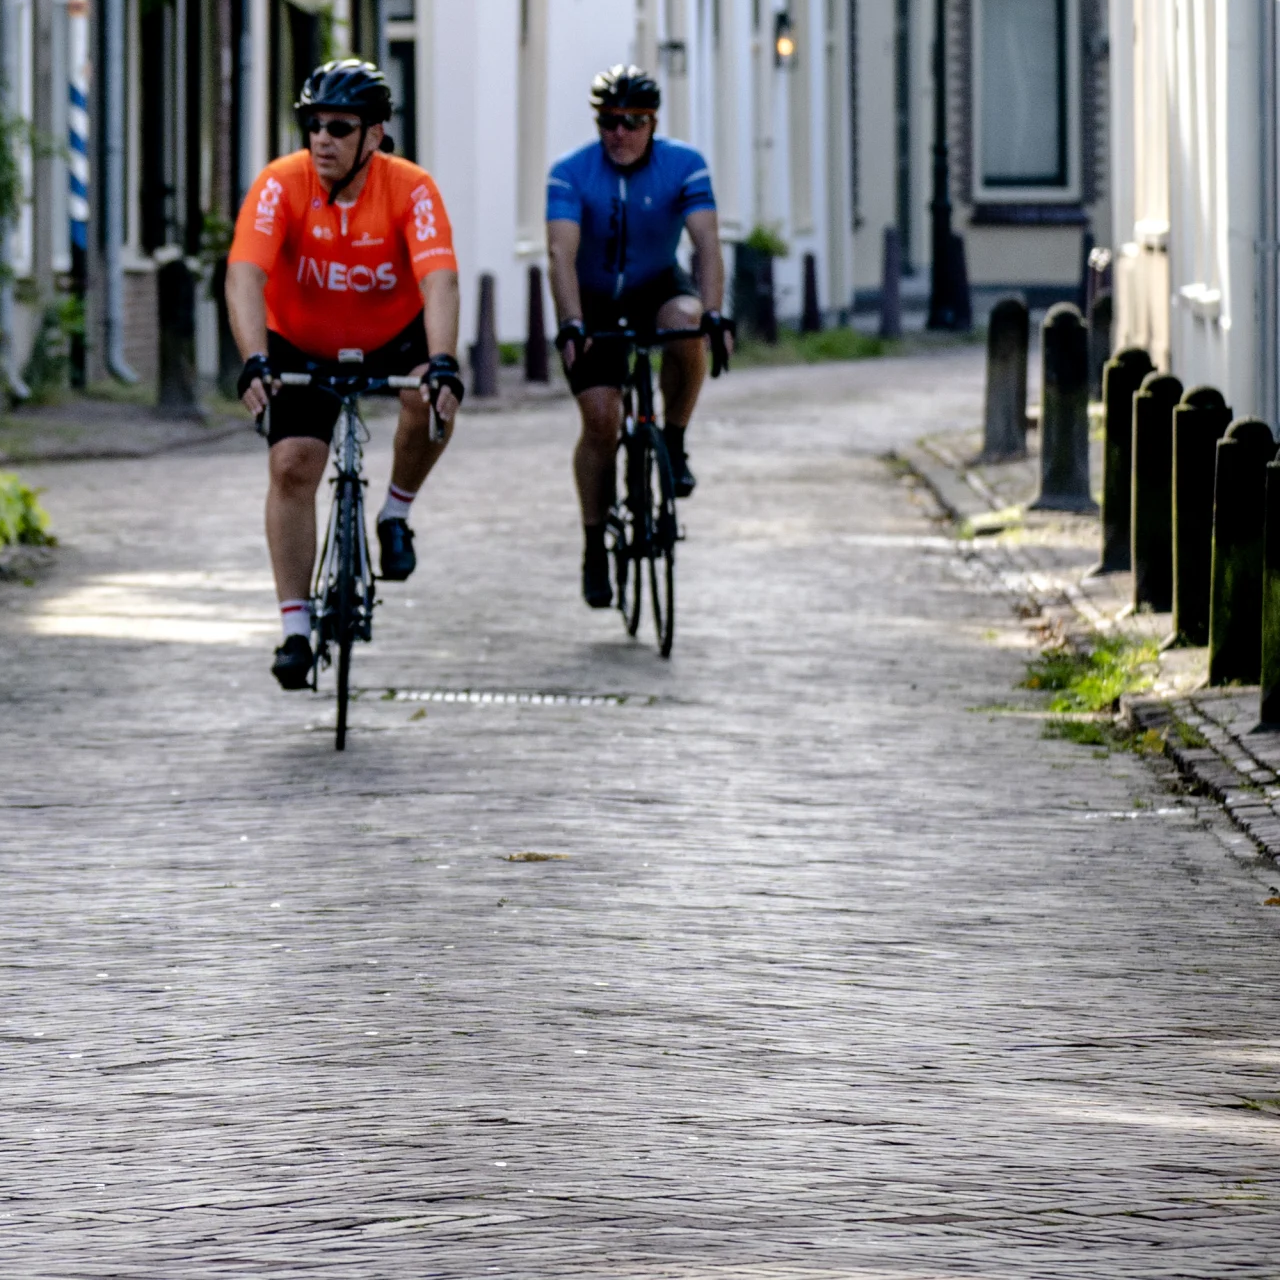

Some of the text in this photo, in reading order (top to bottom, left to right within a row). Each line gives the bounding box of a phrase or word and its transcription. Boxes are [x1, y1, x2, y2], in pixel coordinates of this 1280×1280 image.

[254, 177, 283, 236] INEOS
[410, 184, 437, 242] INEOS
[297, 256, 397, 293] INEOS
